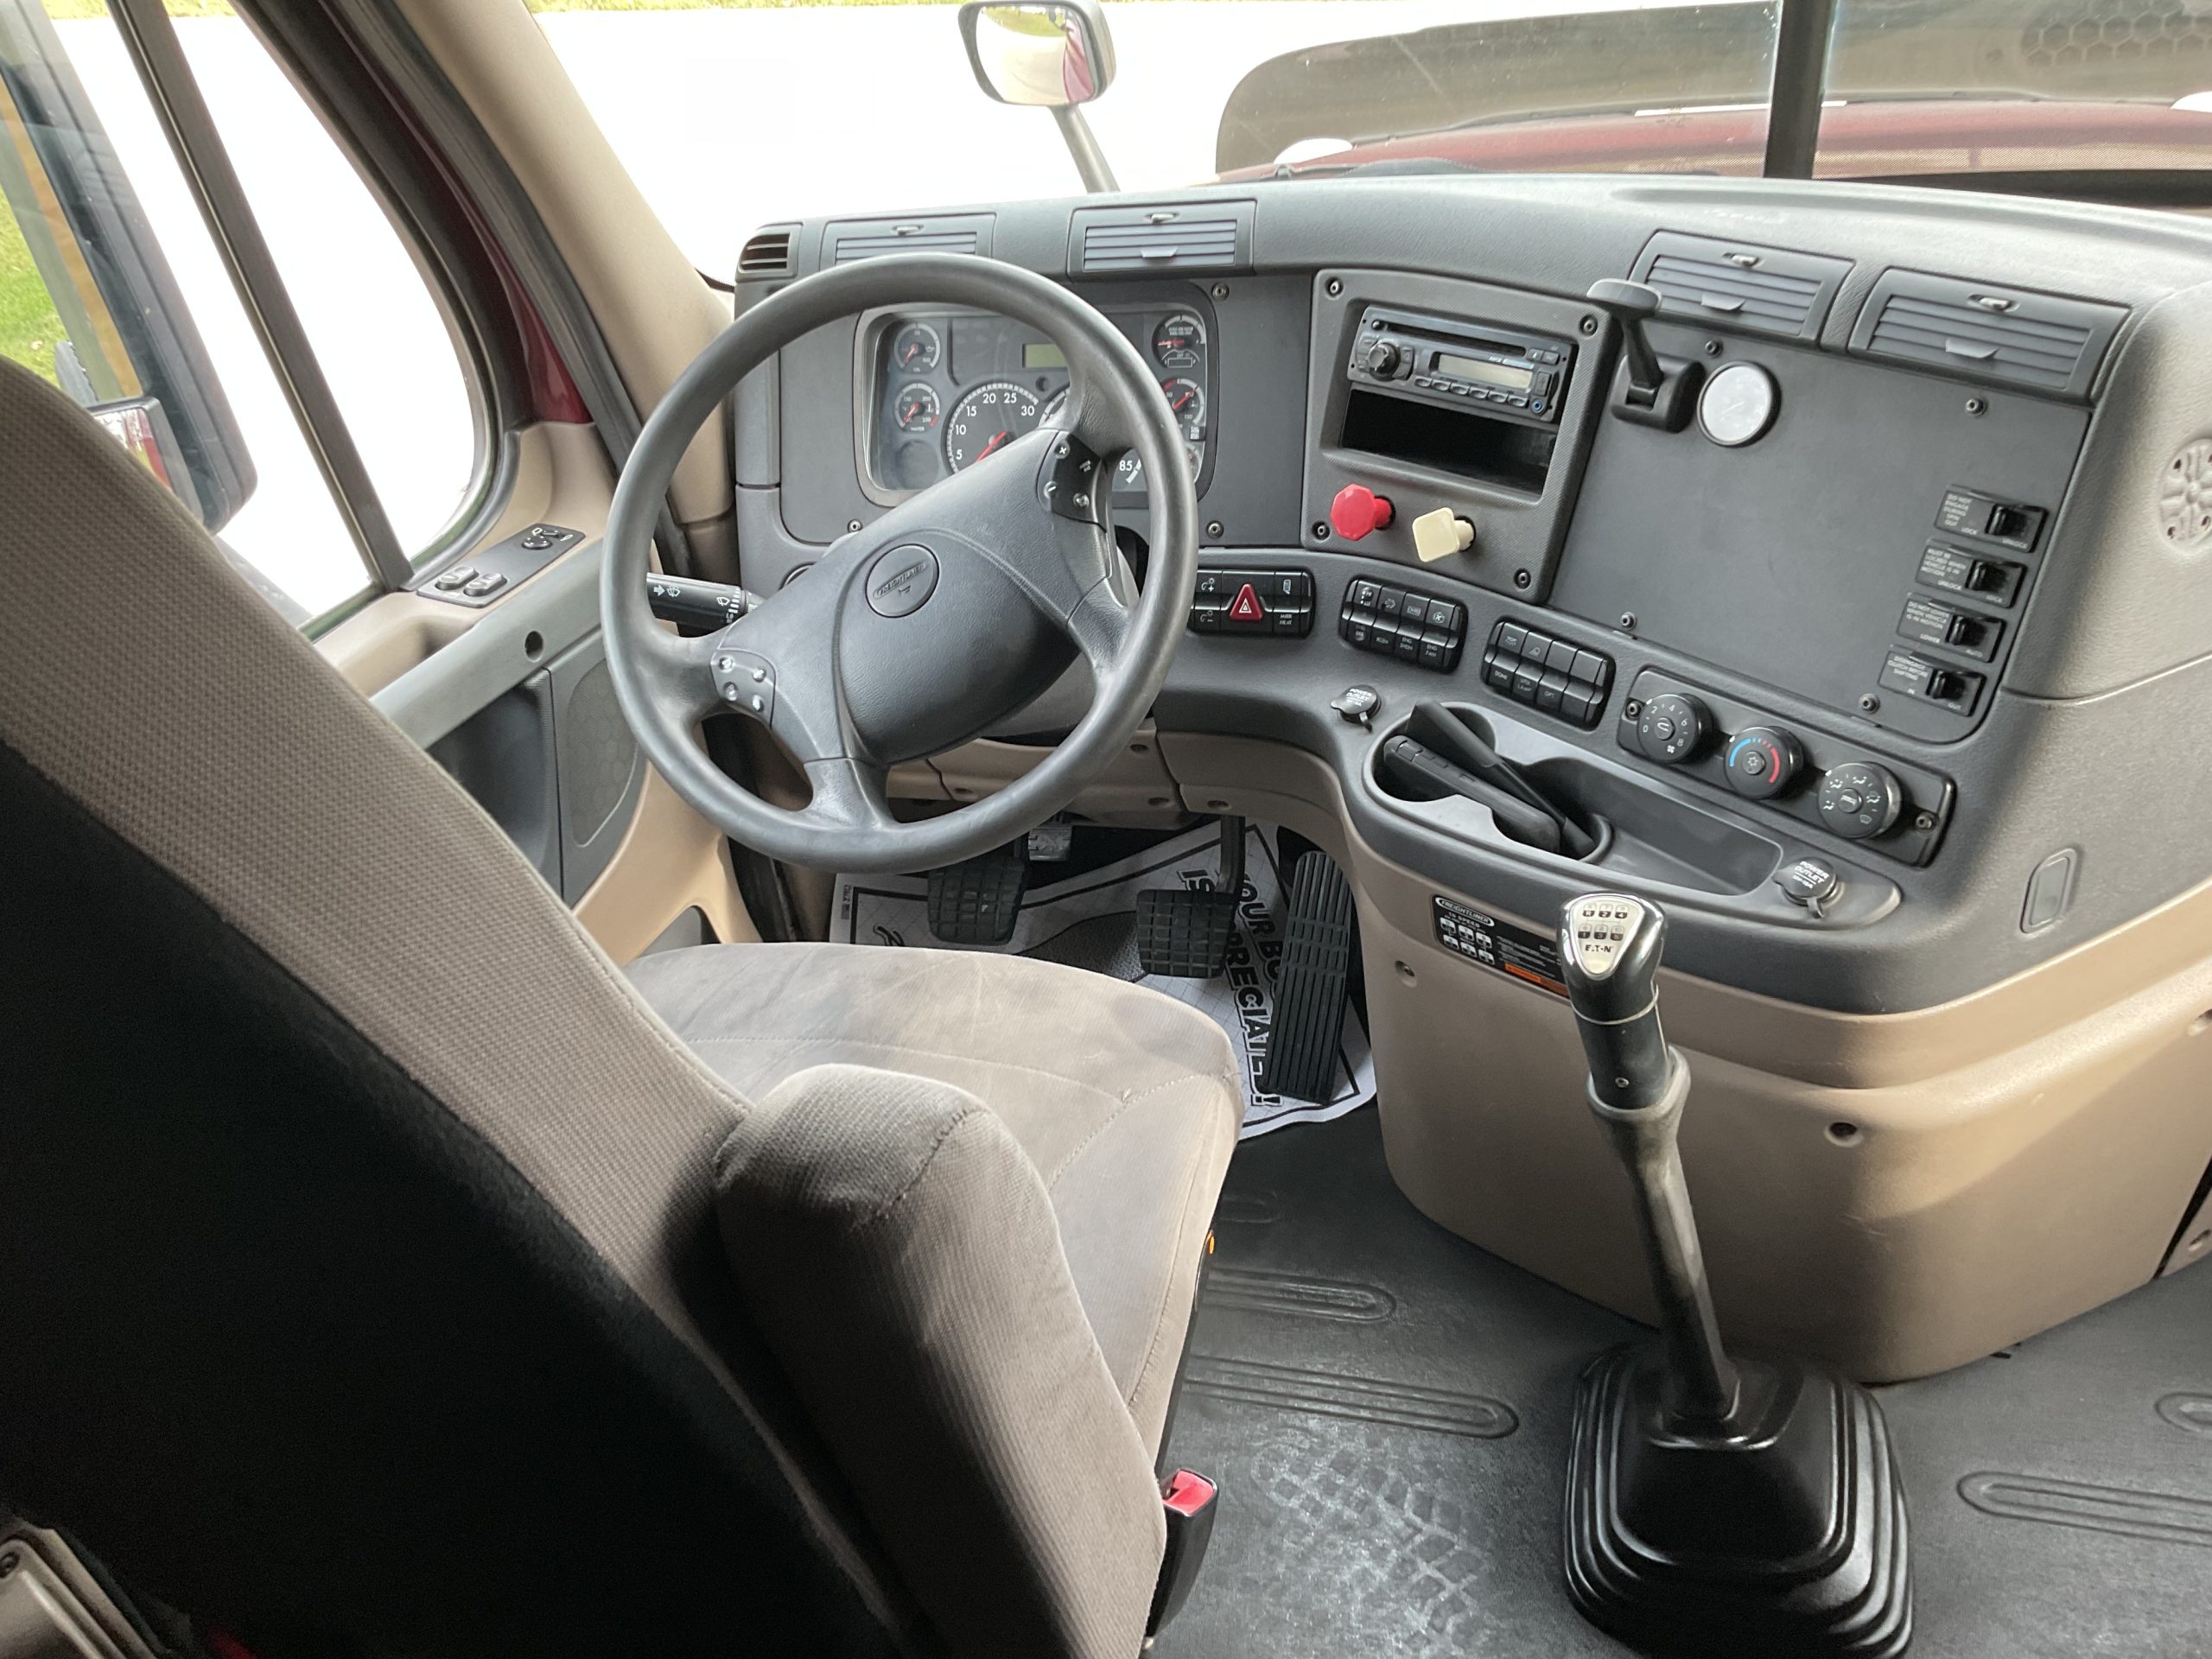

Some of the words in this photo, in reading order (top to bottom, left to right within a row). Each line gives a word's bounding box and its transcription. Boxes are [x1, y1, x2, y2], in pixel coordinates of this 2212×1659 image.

[982, 392, 996, 404] 20
[1003, 392, 1017, 404] 25
[966, 405, 977, 416] 15
[1020, 405, 1035, 416] 30
[955, 424, 967, 435] 10
[955, 448, 963, 460] 5
[1119, 460, 1133, 472] 85
[1937, 580, 1962, 590] UNLOCK
[1965, 648, 1984, 658] AUTO
[1651, 705, 1658, 715] 2
[1643, 724, 1649, 733] 0
[1676, 738, 1684, 747] 8
[1795, 866, 1825, 883] OUTLET
[1800, 861, 1829, 879] POWER
[1441, 899, 1490, 923] FREIGHTLINER
